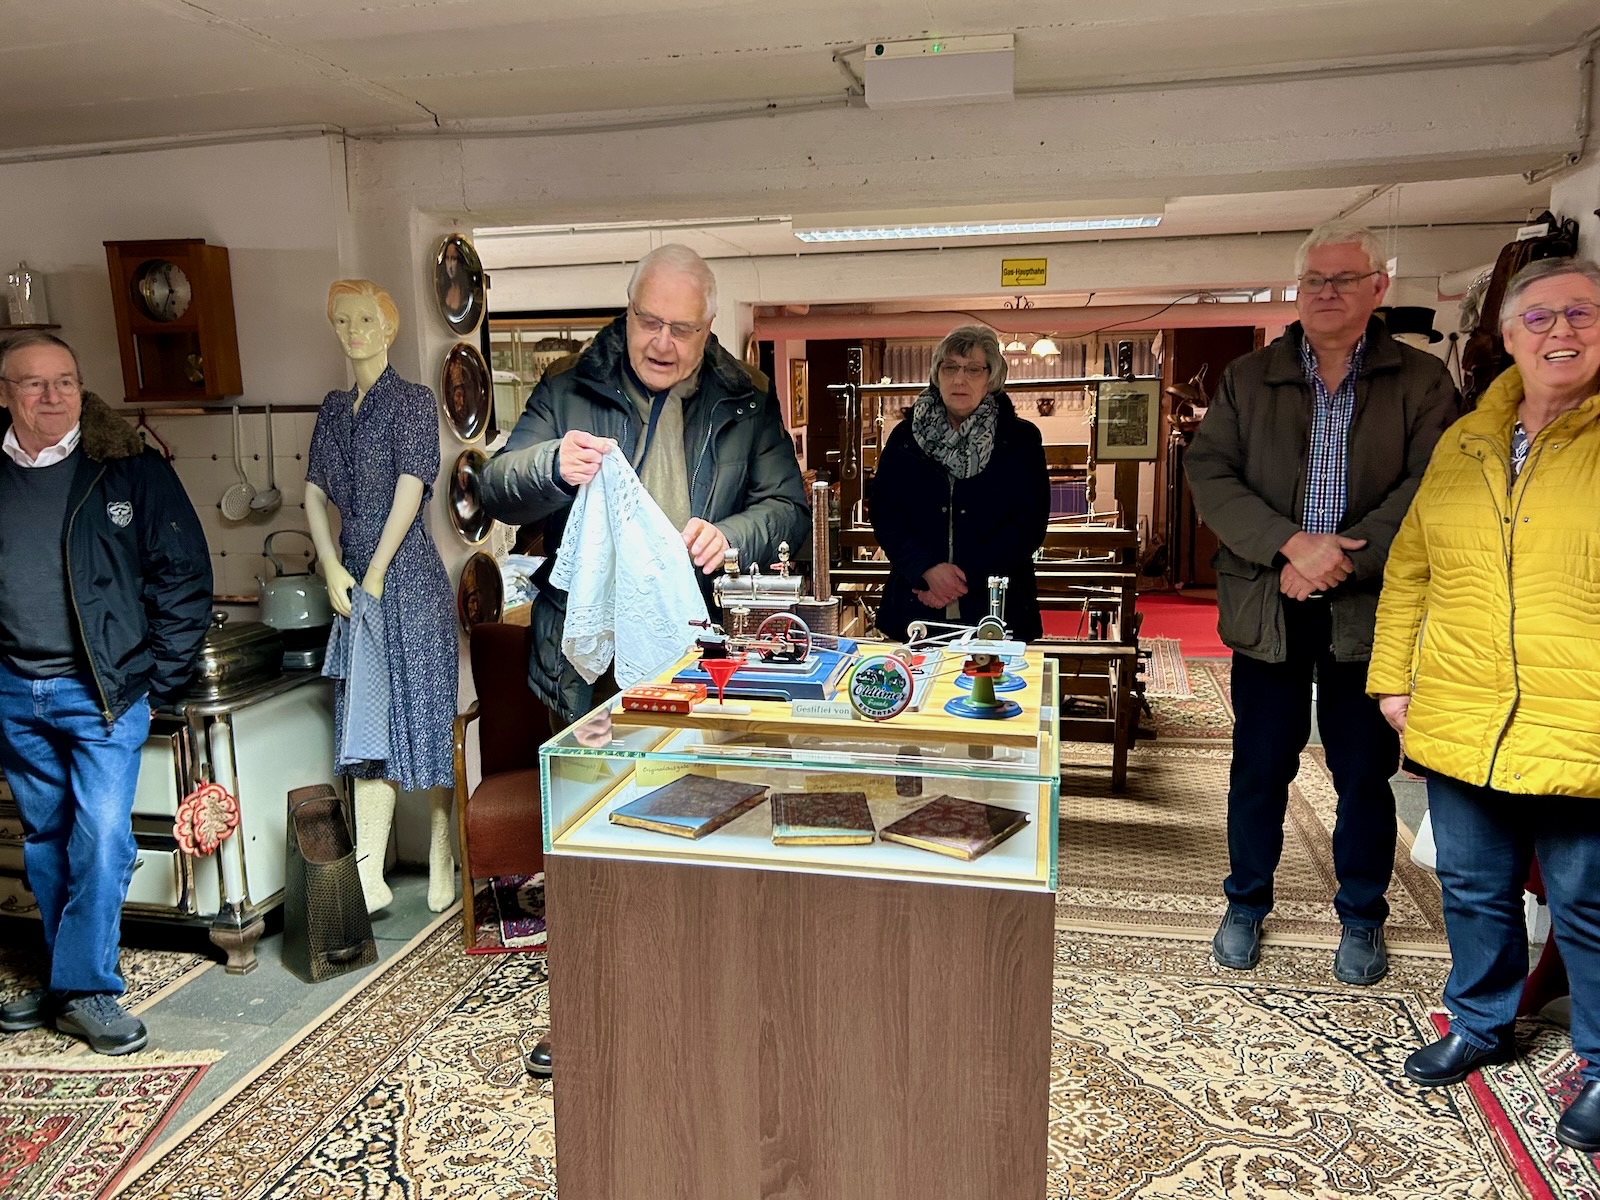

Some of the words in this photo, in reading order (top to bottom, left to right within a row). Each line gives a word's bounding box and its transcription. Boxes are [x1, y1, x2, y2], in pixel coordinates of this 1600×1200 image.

[1003, 267, 1045, 277] Gas-Haupthahn
[853, 683, 907, 702] Oldtimer
[858, 702, 897, 716] EXTERTAL
